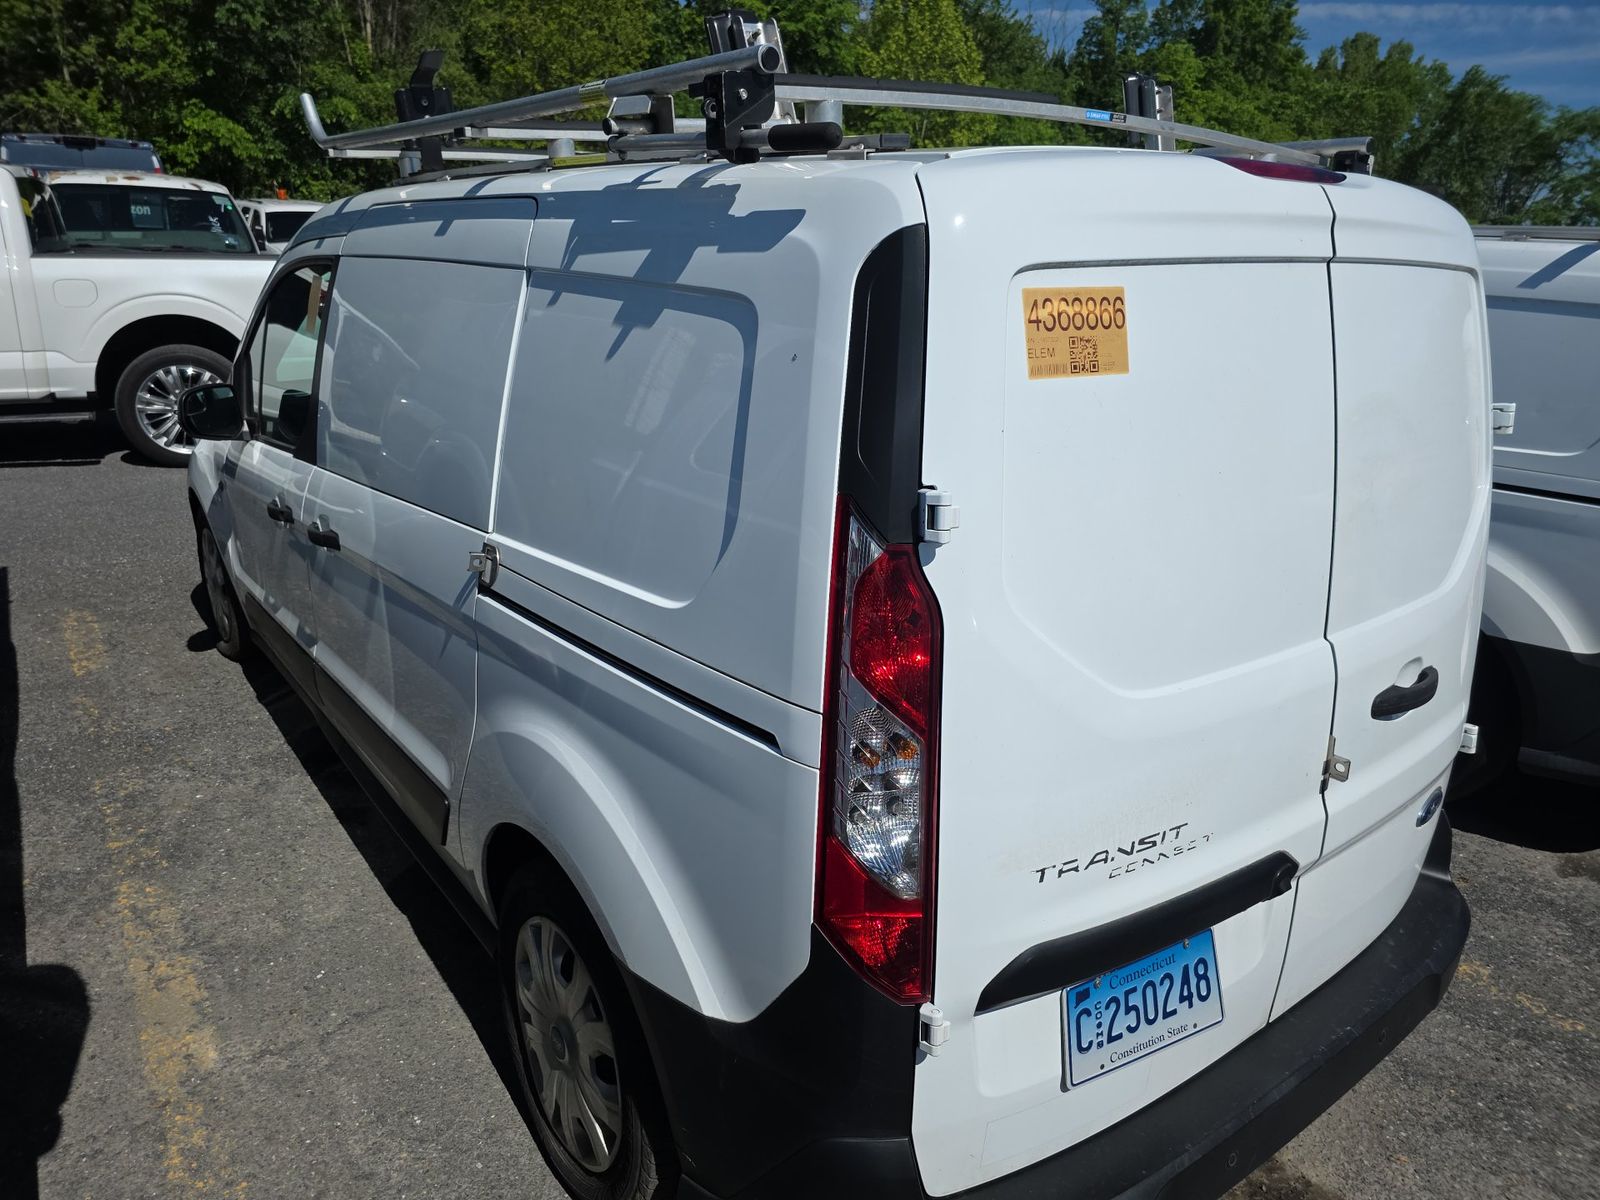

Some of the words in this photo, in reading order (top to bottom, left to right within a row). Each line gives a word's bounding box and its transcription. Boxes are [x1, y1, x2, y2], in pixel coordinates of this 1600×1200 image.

[1027, 296, 1126, 332] 4368866
[1027, 347, 1056, 359] ELEM
[1031, 822, 1189, 883] TRANSIT
[1109, 953, 1177, 990] Connecticut
[1109, 1033, 1166, 1064] Constitution
[1167, 1022, 1189, 1039] State
